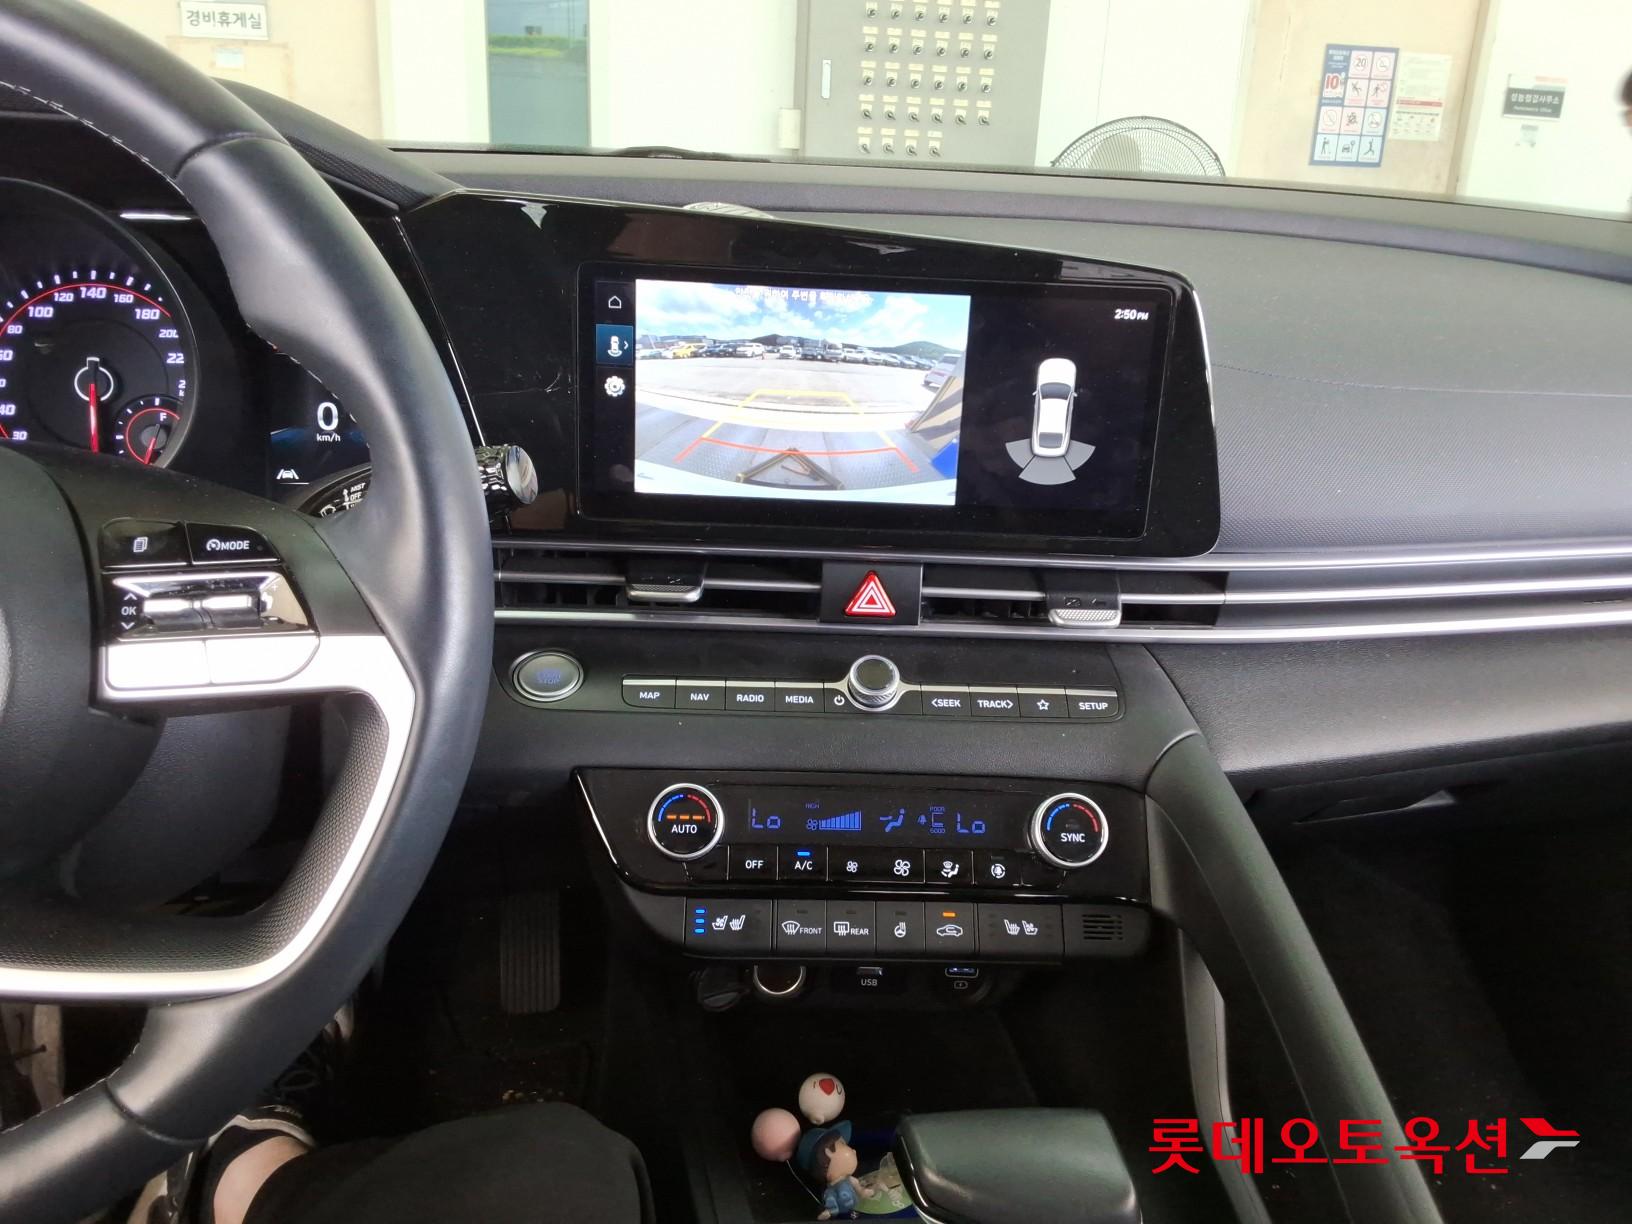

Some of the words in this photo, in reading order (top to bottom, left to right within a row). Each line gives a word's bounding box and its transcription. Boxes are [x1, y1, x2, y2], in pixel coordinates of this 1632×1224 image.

[186, 10, 262, 29] 경비휴게실
[53, 292, 74, 302] 120
[80, 287, 107, 299] 140
[113, 294, 134, 303] 160
[28, 306, 54, 318] 100
[134, 309, 160, 320] 180
[1114, 308, 1137, 320] 2:50
[7, 325, 23, 334] 80
[160, 412, 167, 421] F
[317, 401, 339, 431] 0
[12, 431, 28, 441] 30
[316, 431, 341, 442] km/h
[220, 540, 250, 550] MODE
[121, 606, 137, 615] OK
[639, 691, 660, 699] MAP
[690, 693, 709, 701] NAV
[736, 694, 764, 703] RADIO
[785, 695, 814, 704] MEDIA
[1079, 702, 1109, 711] SETUP
[671, 824, 698, 834] AUTO
[1060, 832, 1086, 843] SYNC
[745, 860, 764, 870] OFF
[794, 860, 813, 871] A/C
[800, 927, 822, 935] FRONT
[850, 927, 869, 935] REAR
[860, 978, 878, 987] USB
